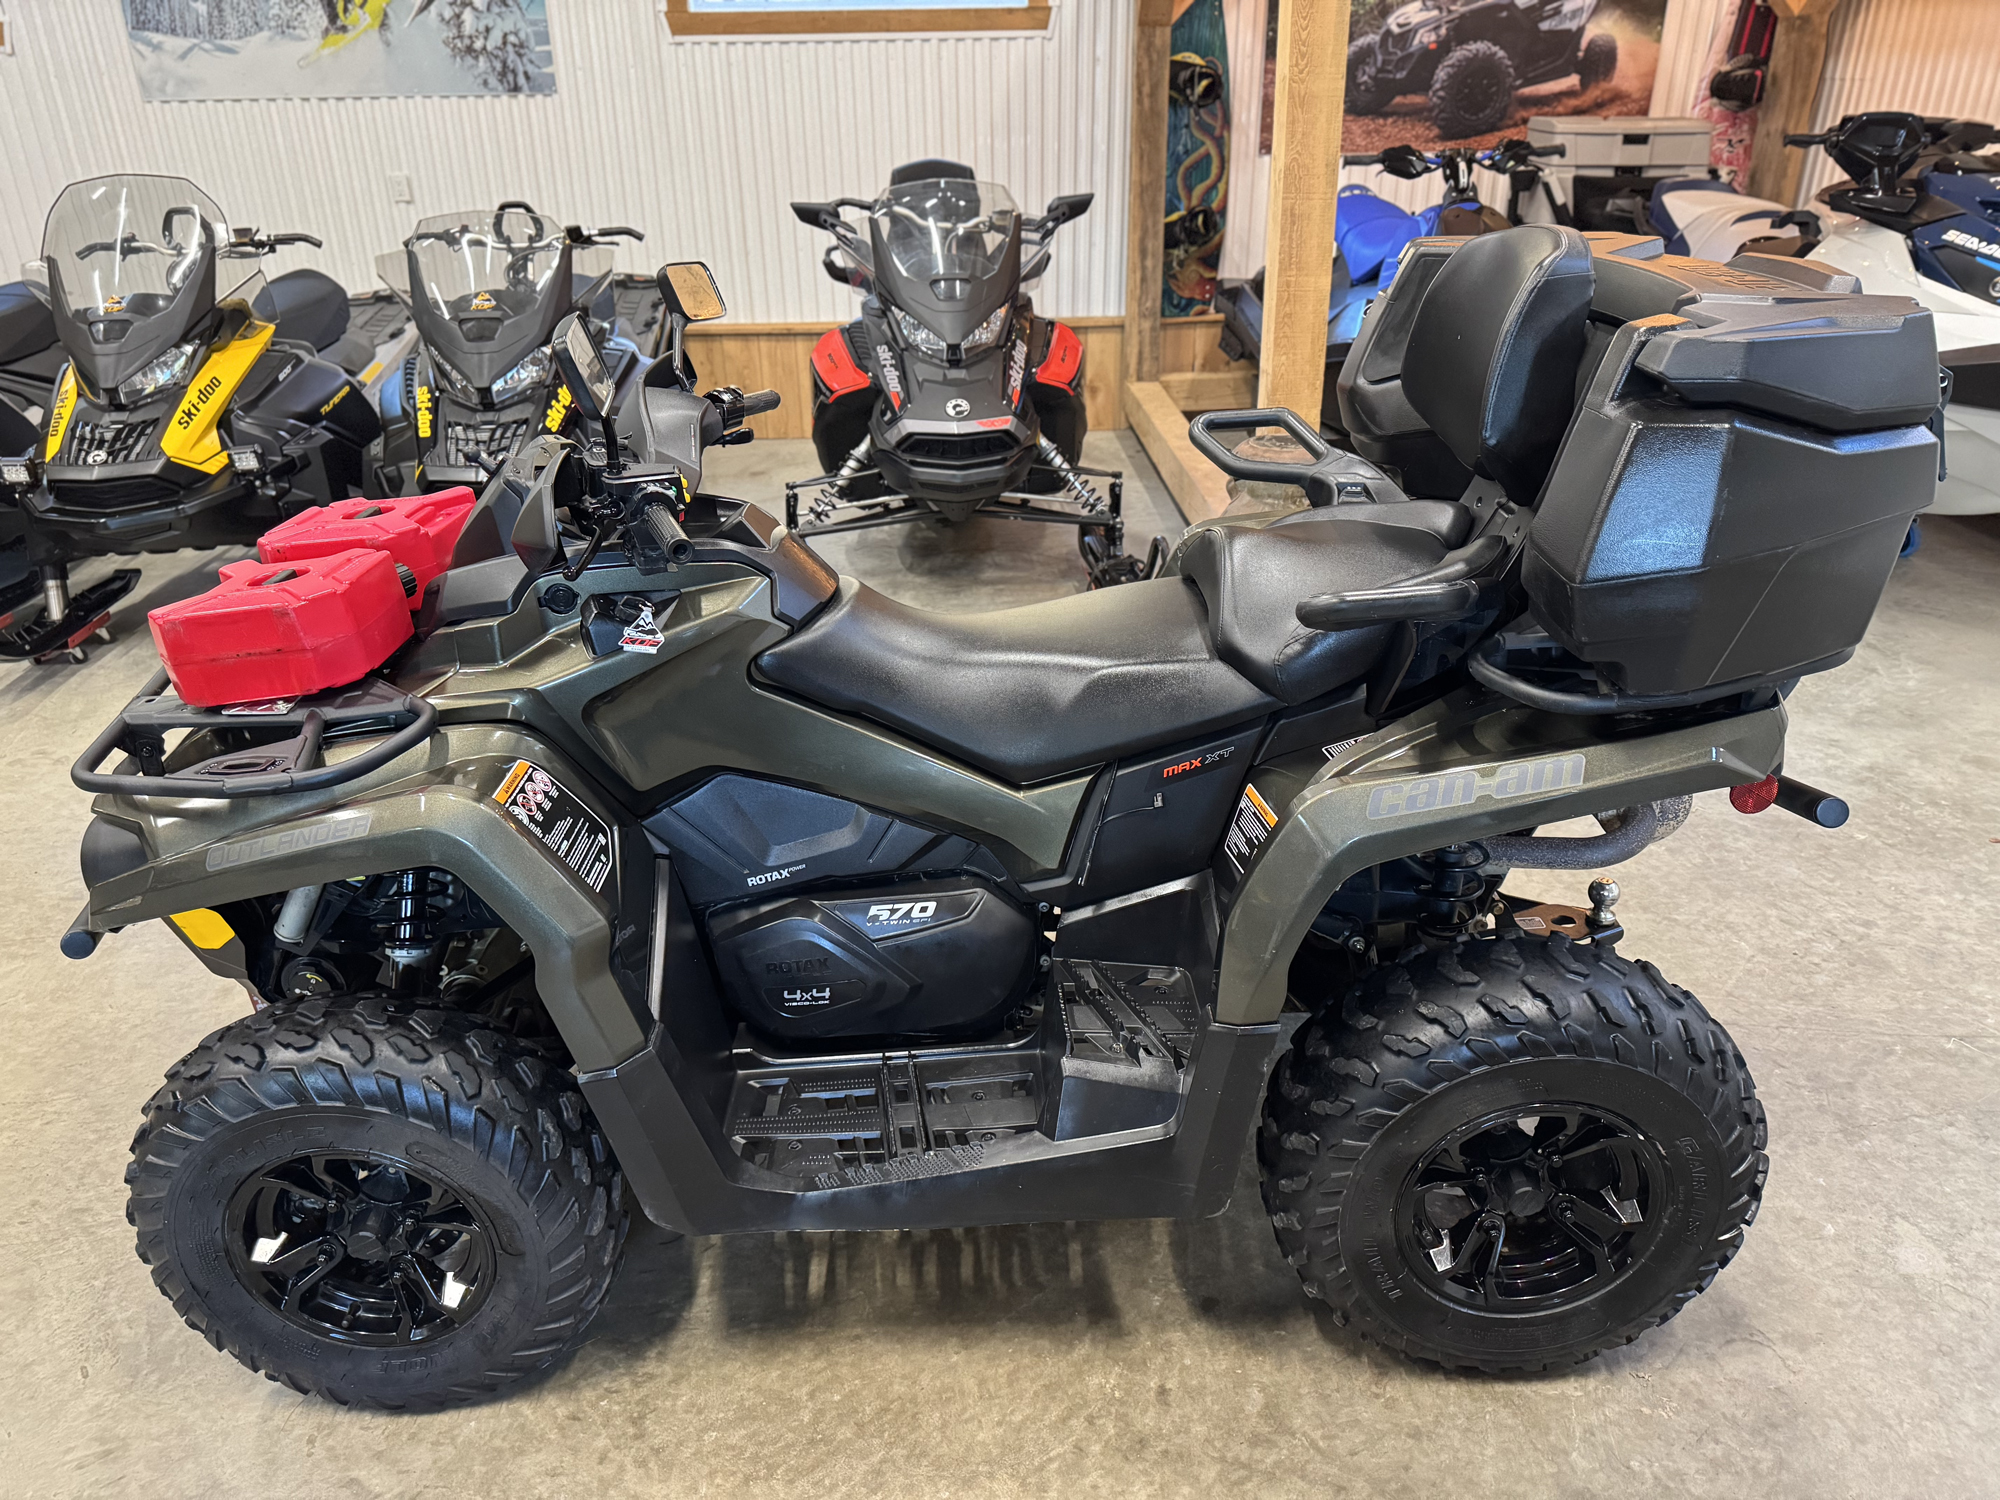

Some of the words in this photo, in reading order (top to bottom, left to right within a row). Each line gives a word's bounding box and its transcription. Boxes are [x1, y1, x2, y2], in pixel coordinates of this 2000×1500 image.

[876, 344, 901, 393] ski-doo
[1010, 339, 1028, 391] ski-doo
[50, 389, 68, 437] ski-doo
[177, 376, 222, 430] ski-doo
[417, 386, 433, 438] ski-doo
[545, 384, 572, 433] ski-d
[621, 637, 662, 647] KDF
[1163, 757, 1203, 778] MAX
[1204, 746, 1235, 764] XT
[1367, 754, 1585, 819] can-am
[206, 814, 371, 871] OUTLANDER
[747, 868, 791, 887] ROTAX
[867, 901, 937, 921] 570
[766, 957, 831, 975] ROTAX
[784, 987, 831, 1001] 4x4
